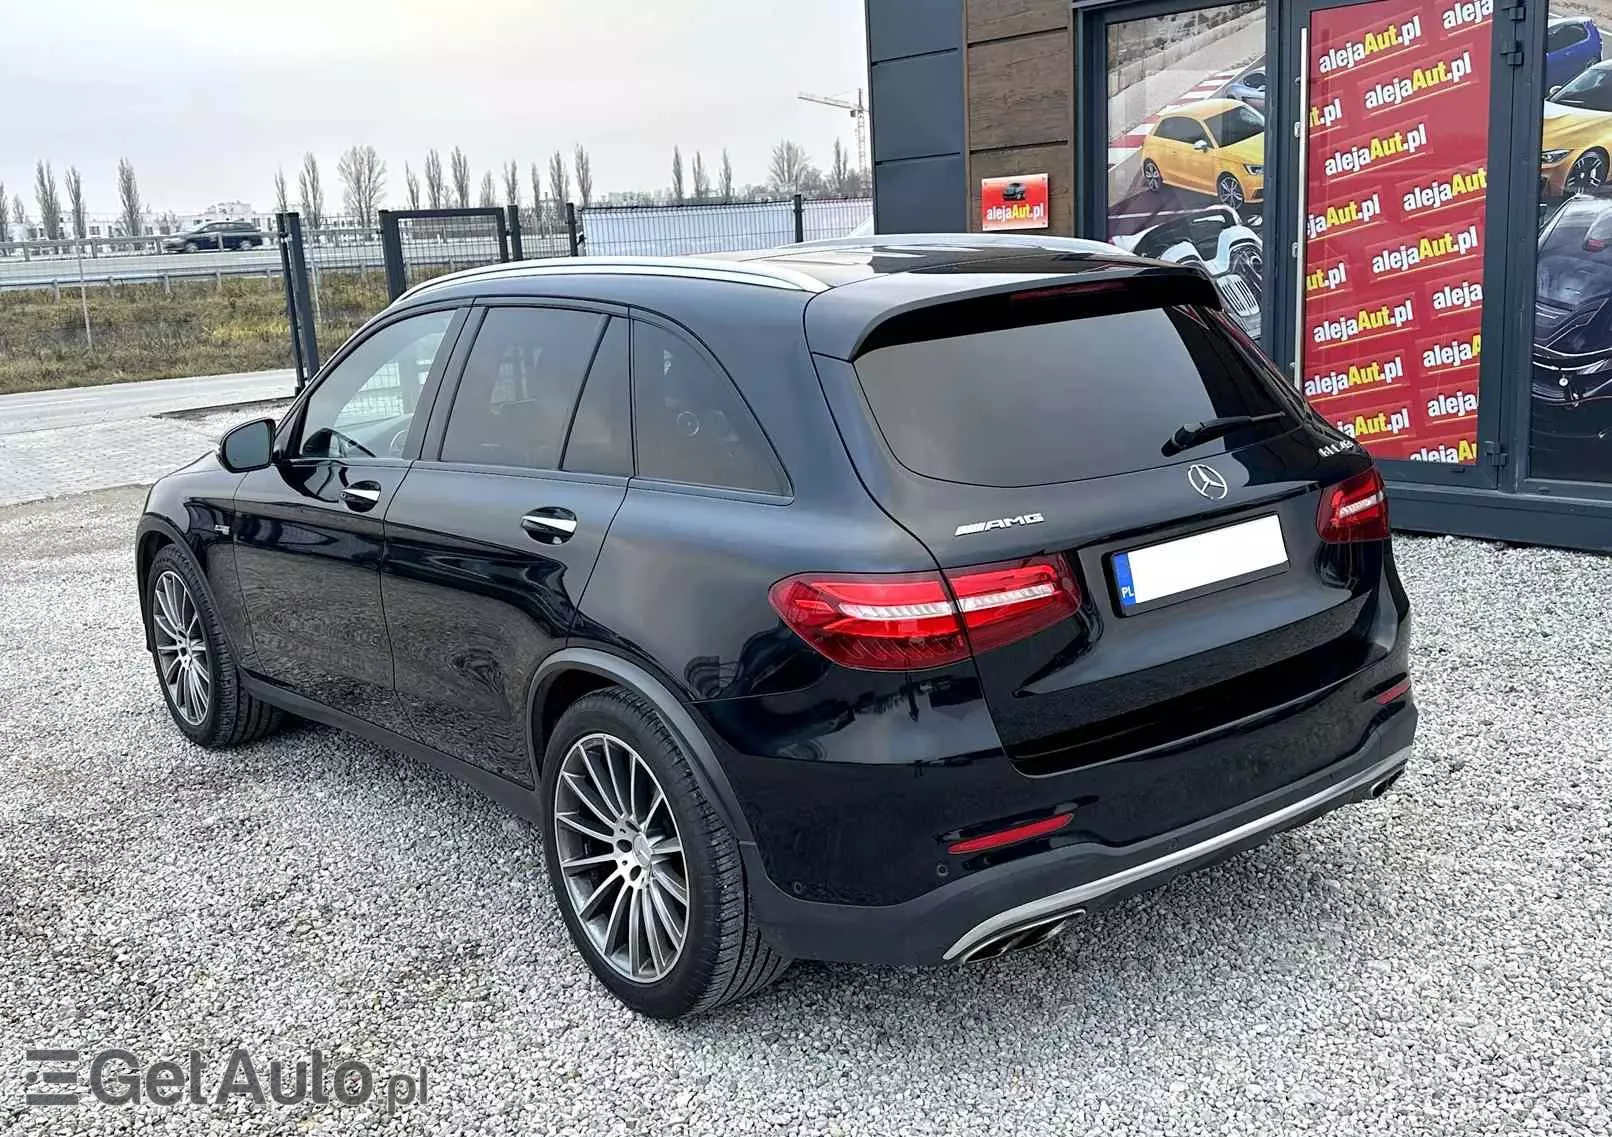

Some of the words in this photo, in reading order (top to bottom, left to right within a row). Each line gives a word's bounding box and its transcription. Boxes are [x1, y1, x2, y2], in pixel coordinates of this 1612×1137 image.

[1319, 15, 1421, 73] alejaAut.pl
[1364, 52, 1472, 109] alejaAut.pl
[1325, 123, 1427, 176] alejaAut.pl
[1403, 167, 1487, 212] alejaAut
[986, 202, 1044, 222] alejaAut.pl
[1372, 226, 1478, 274] alejaAut.pl
[1432, 281, 1482, 310] aleja
[1313, 300, 1413, 343] alejaAut.pl
[1304, 357, 1403, 396] alejaAut.pl
[1428, 391, 1479, 416] aleja
[984, 512, 1045, 531] AMG
[1121, 586, 1135, 598] PL
